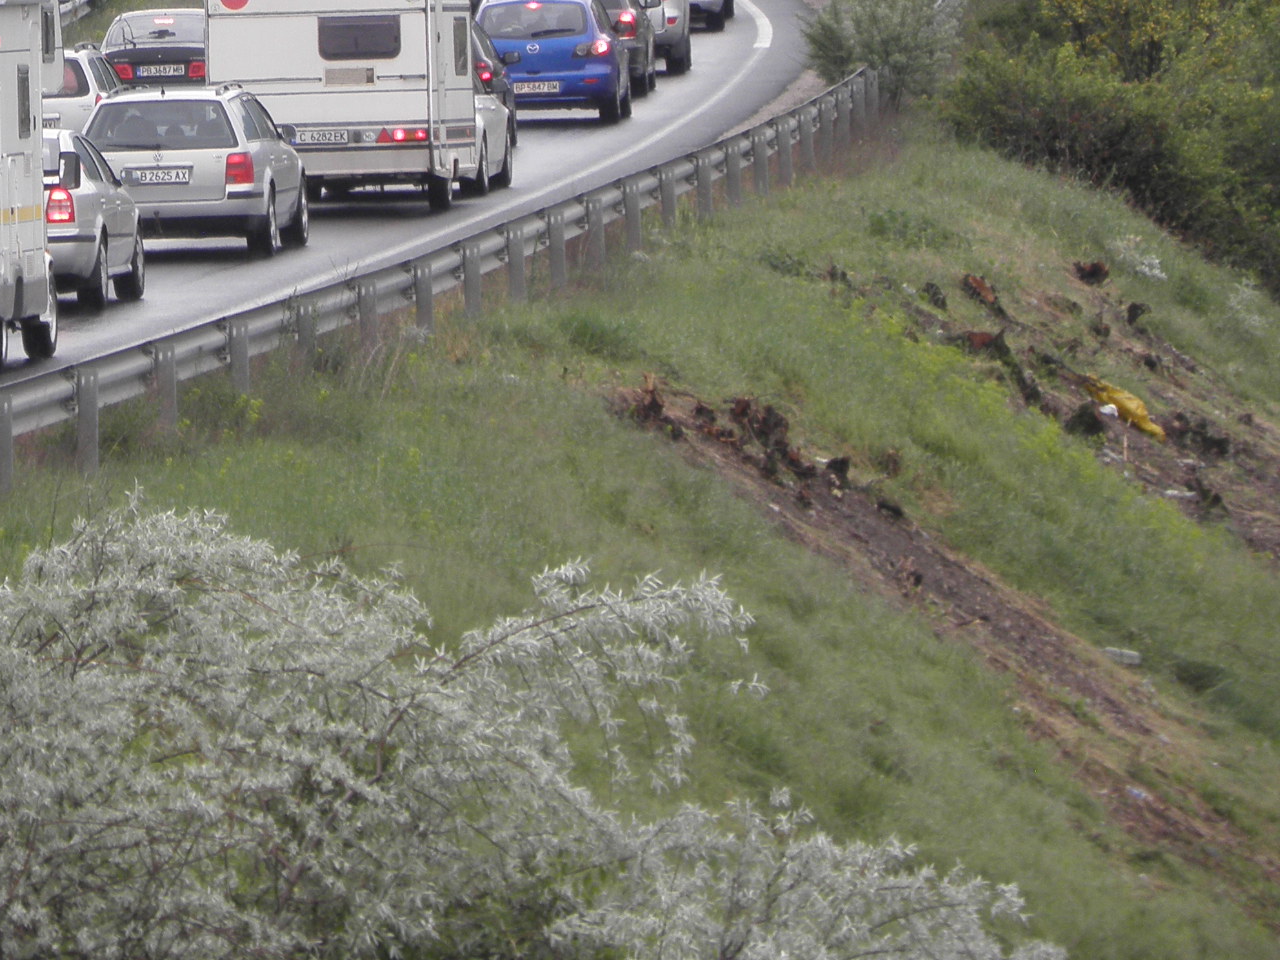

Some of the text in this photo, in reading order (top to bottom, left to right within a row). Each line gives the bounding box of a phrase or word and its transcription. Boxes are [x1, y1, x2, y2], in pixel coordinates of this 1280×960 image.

[140, 170, 188, 182] B 2625 AX
